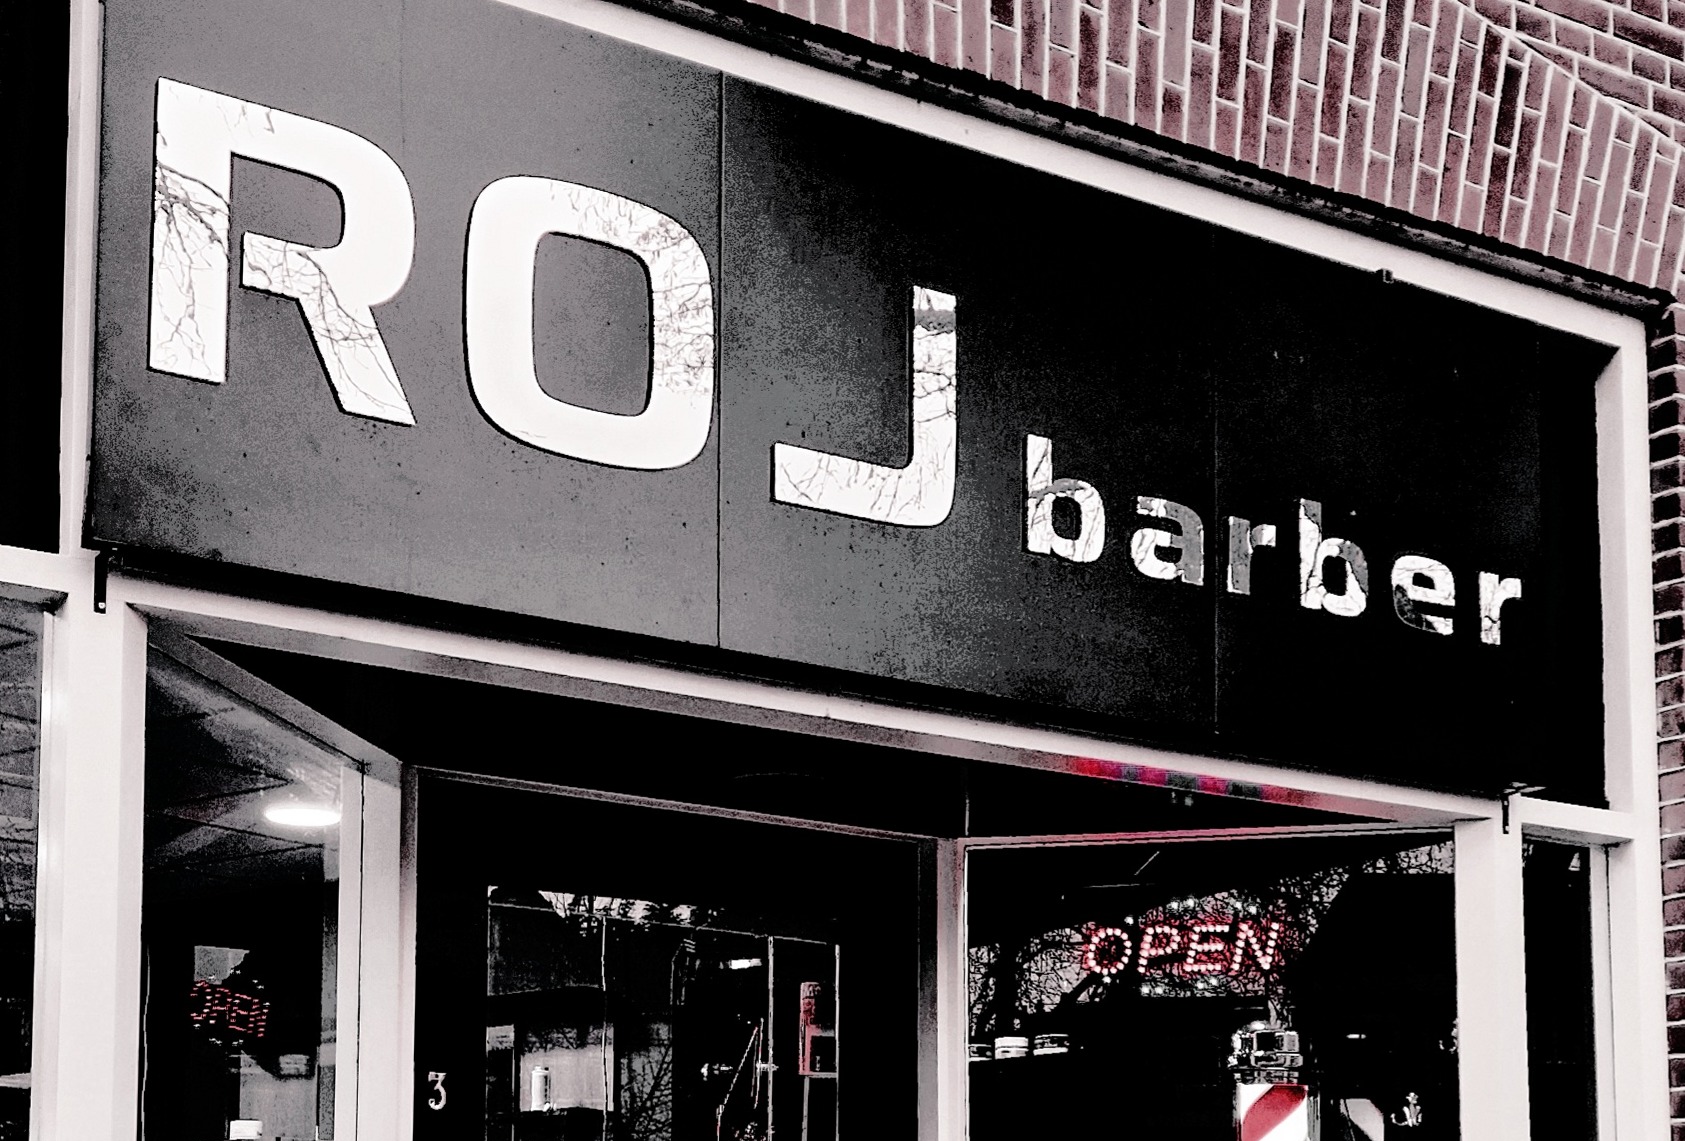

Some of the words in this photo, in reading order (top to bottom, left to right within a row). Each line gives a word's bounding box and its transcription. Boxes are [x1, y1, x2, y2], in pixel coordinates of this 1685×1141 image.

[147, 76, 957, 527] ROJ
[1026, 433, 1522, 645] barber
[1088, 922, 1280, 974] OPEN
[427, 1071, 448, 1110] 3
